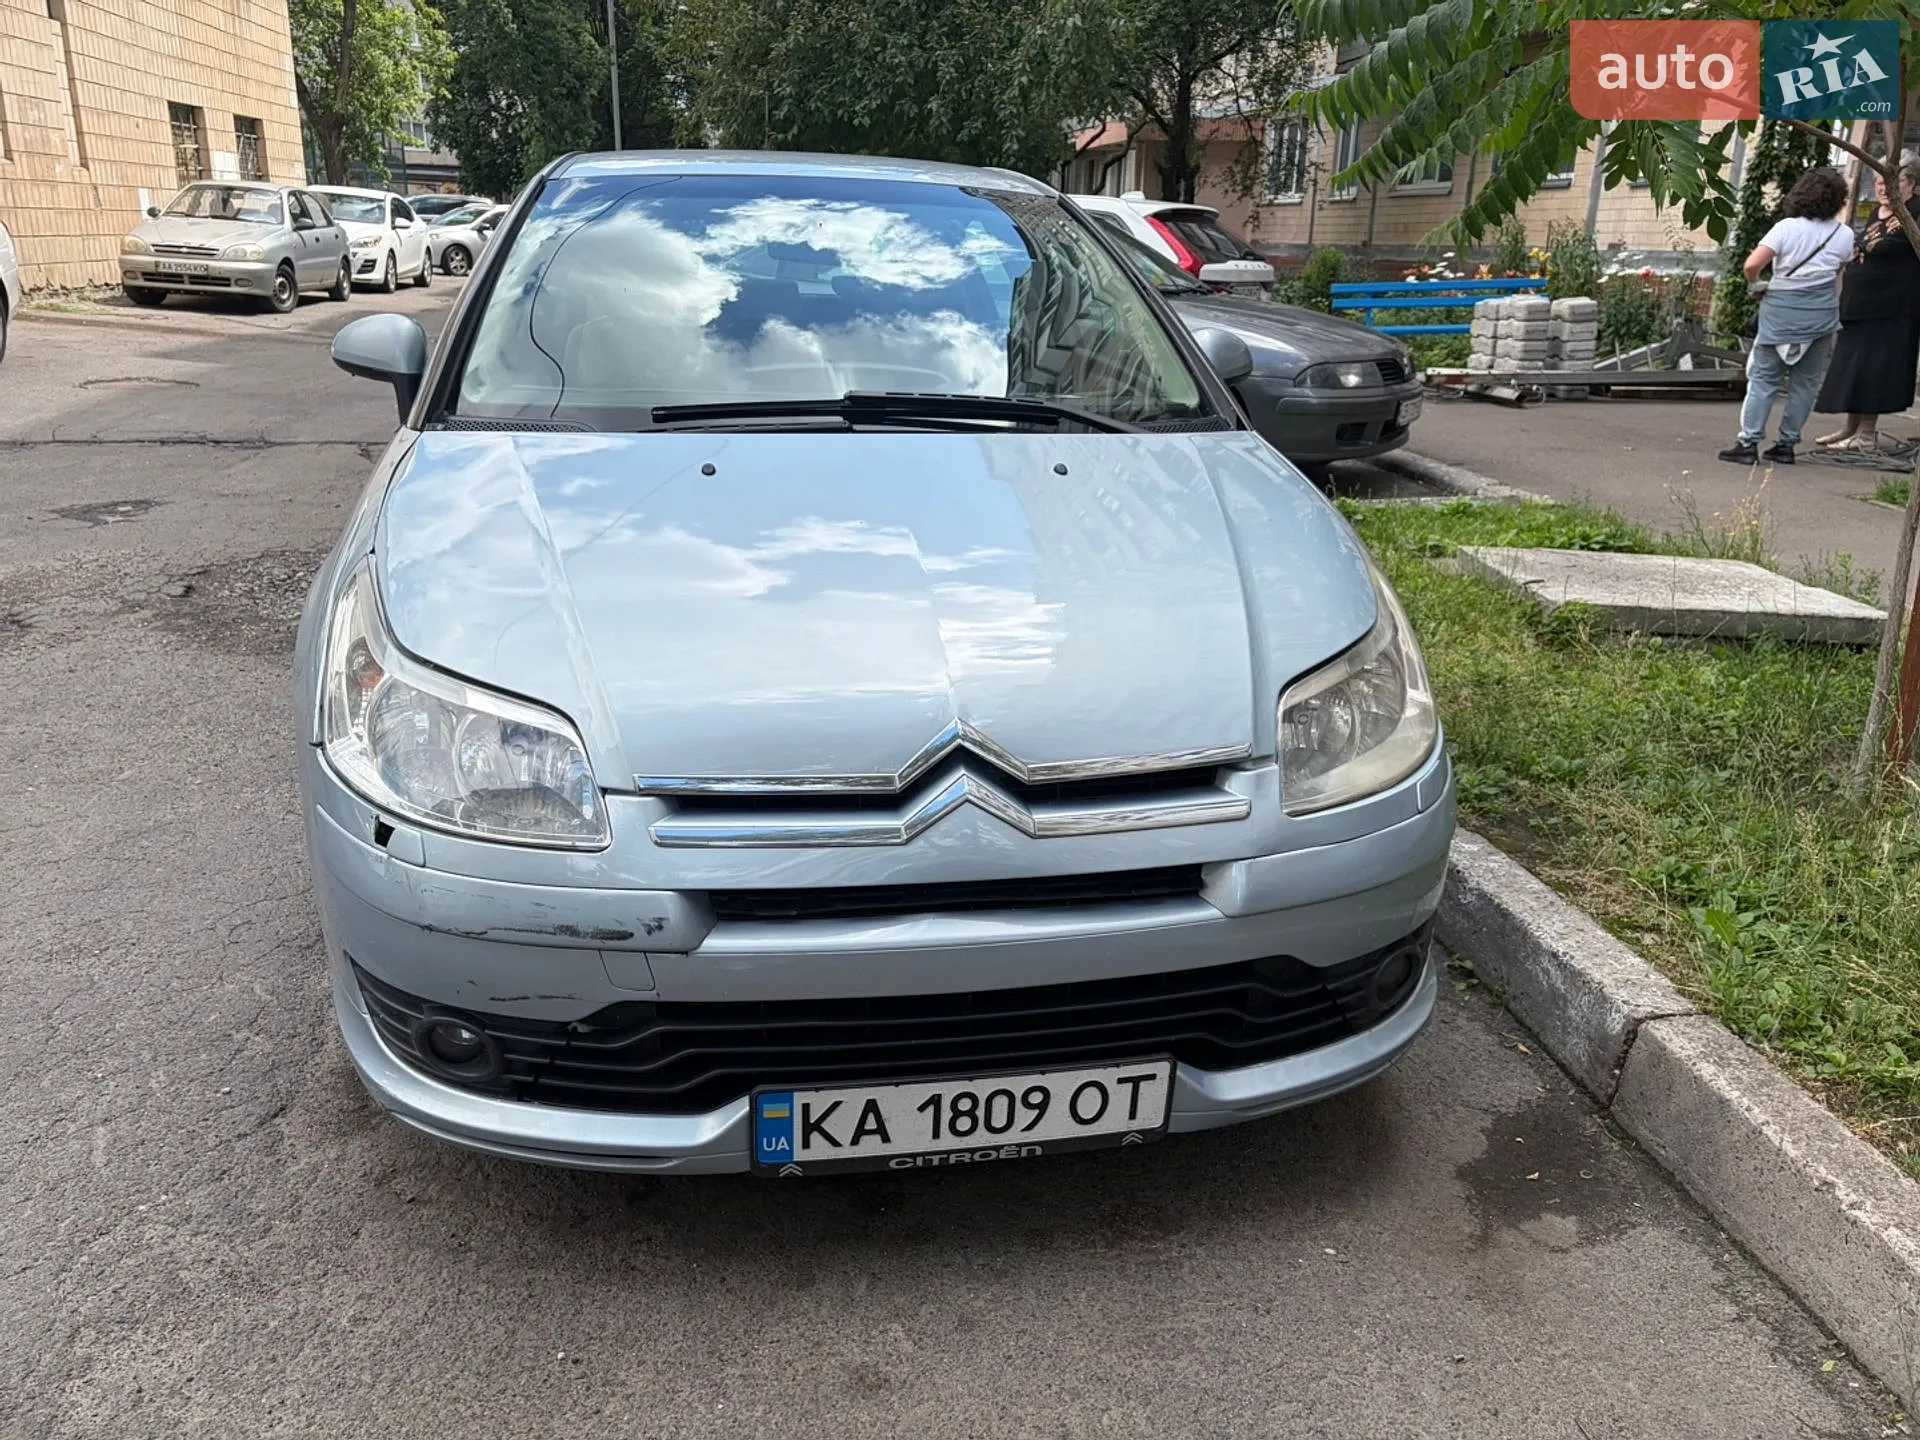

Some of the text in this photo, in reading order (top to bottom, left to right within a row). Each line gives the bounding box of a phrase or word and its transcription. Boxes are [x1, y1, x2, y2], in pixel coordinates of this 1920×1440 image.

[801, 1073, 1157, 1150] KA 1809 OT
[762, 1136, 790, 1151] UA
